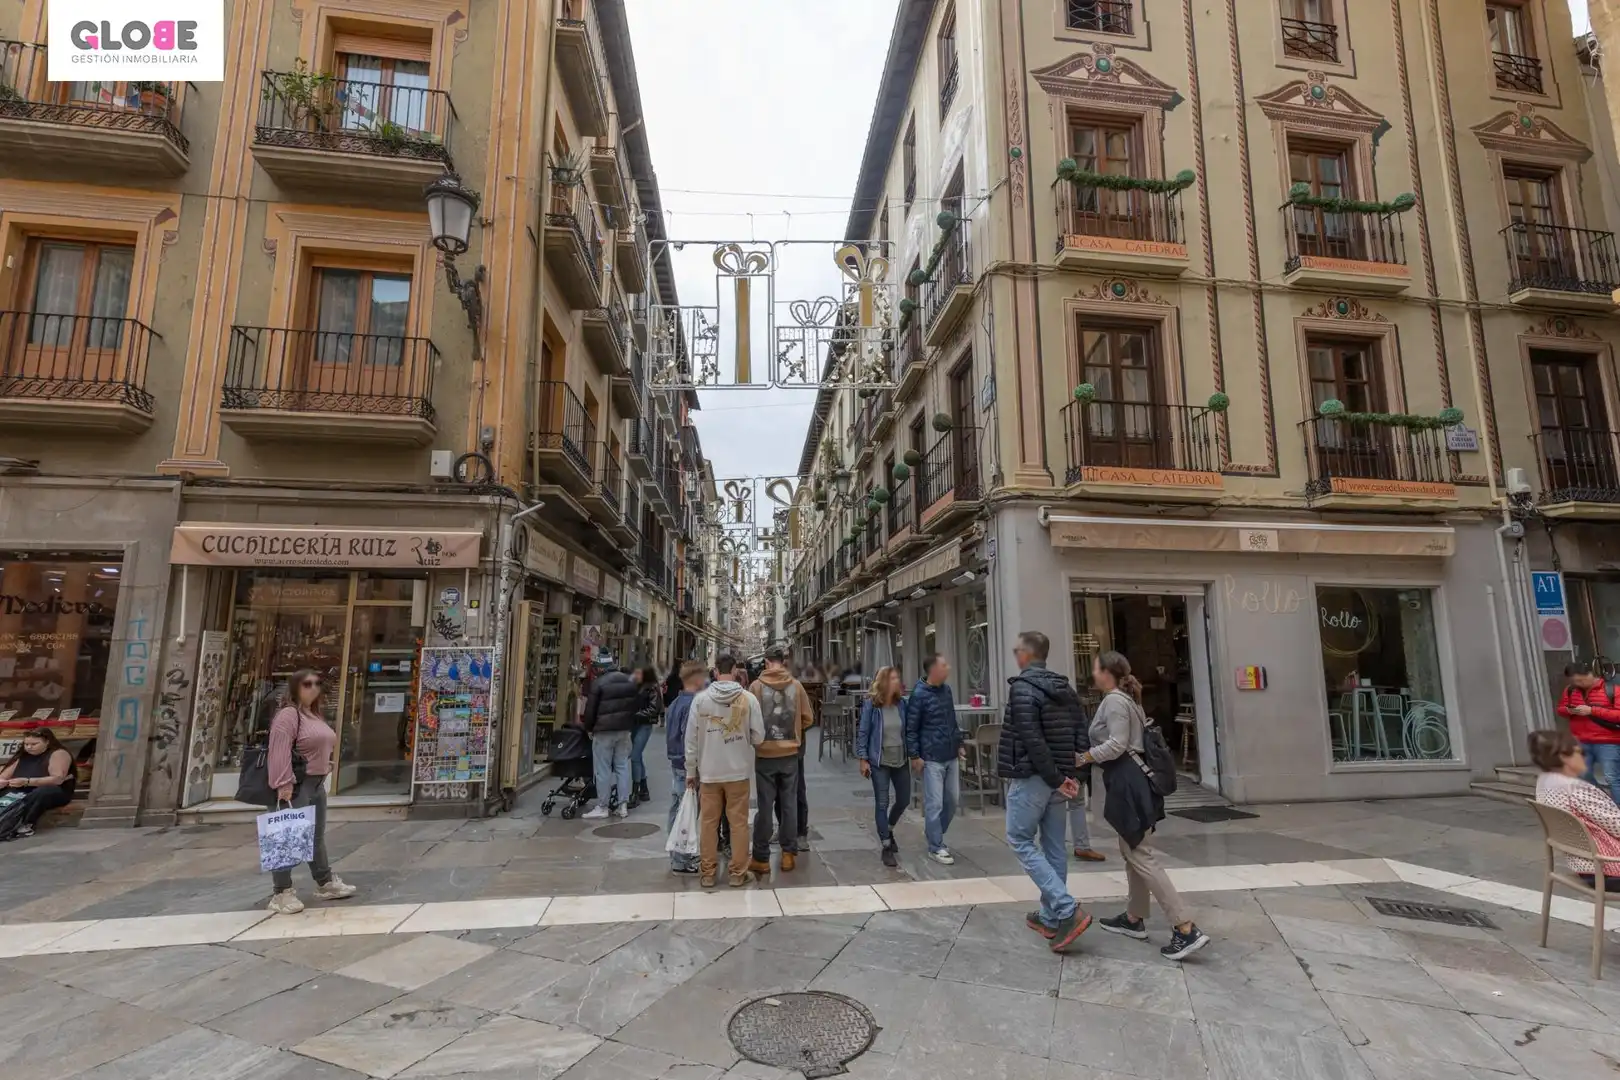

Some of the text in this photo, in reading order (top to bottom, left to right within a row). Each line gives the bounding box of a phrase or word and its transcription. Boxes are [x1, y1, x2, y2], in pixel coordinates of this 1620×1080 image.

[1080, 239, 1186, 256] CASA CATEDRAL
[1100, 470, 1137, 482] CASA
[202, 533, 397, 557] CUCHILLERÍA RUIZ
[1537, 575, 1556, 593] AT
[1224, 574, 1307, 615] Rollo
[1320, 606, 1362, 628] Rollo
[267, 812, 305, 825] FRIKING
